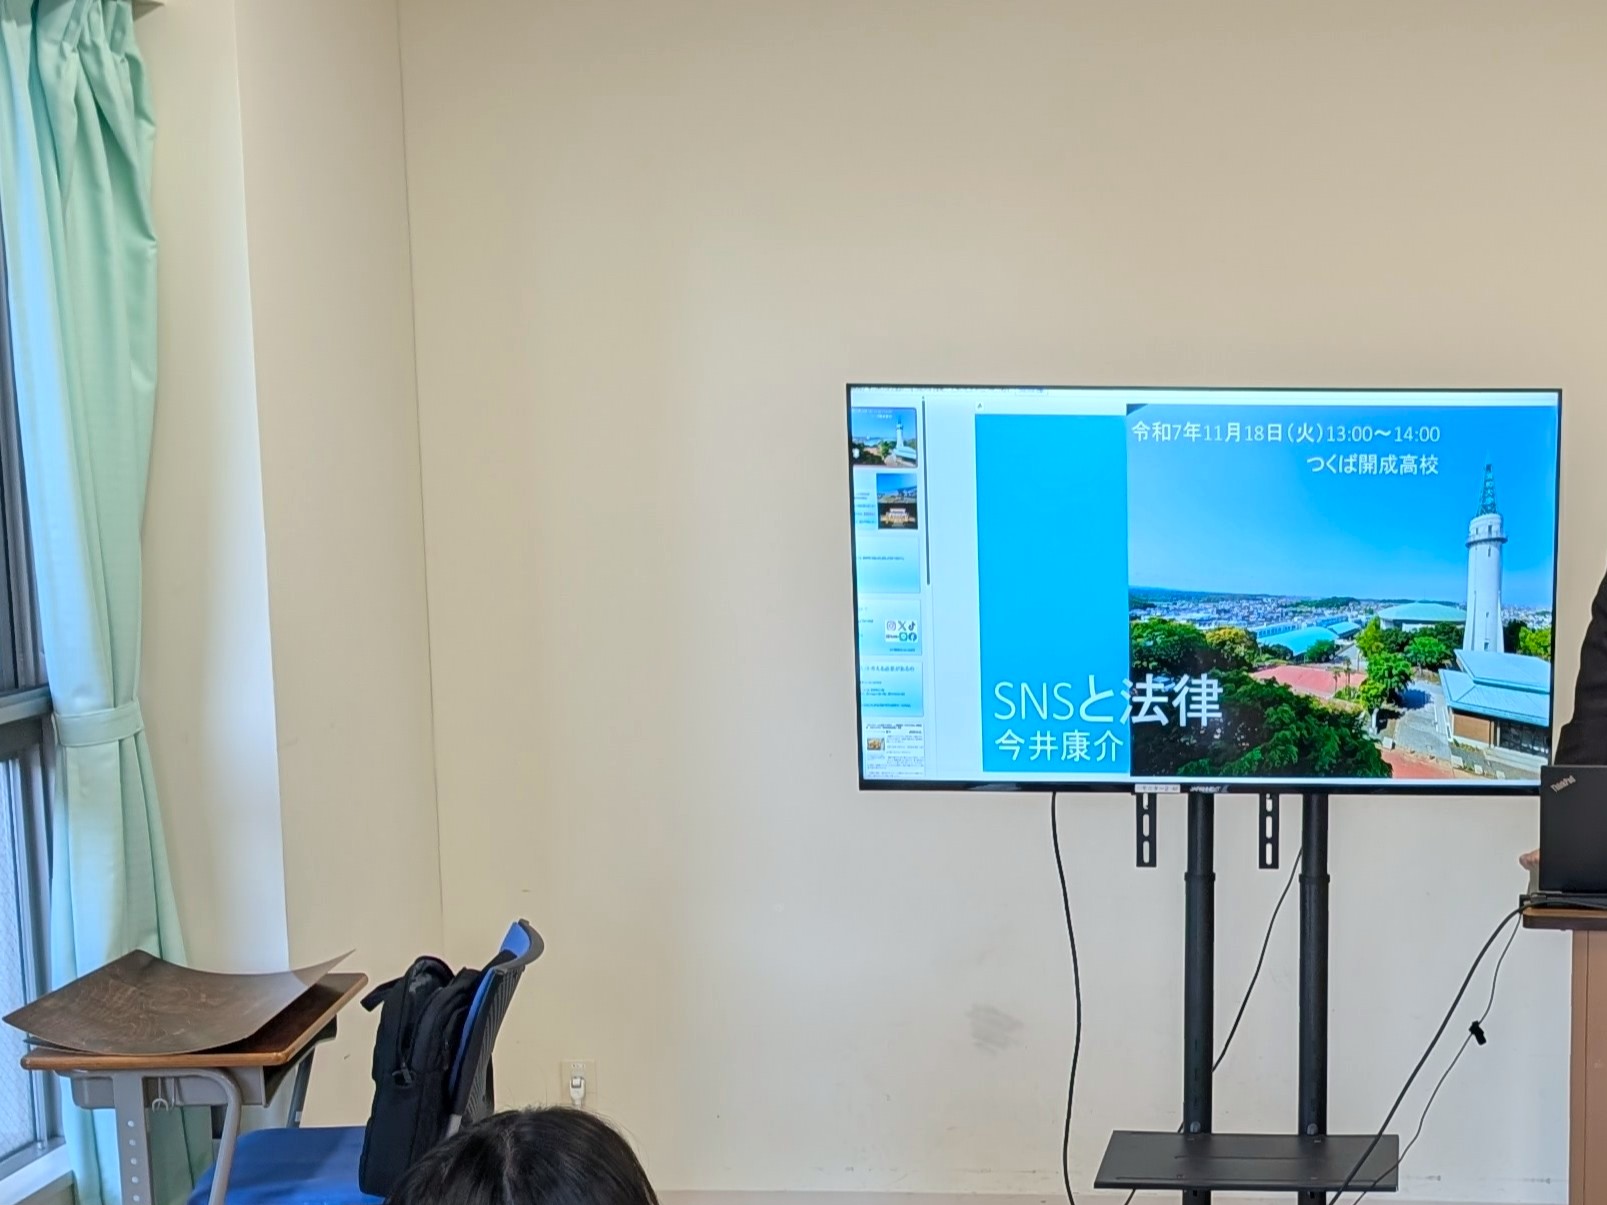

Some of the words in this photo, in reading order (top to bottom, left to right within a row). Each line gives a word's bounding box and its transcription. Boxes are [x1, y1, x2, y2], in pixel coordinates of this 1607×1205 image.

[1306, 453, 1439, 475] つくば開成高校
[993, 672, 1224, 728] SNSと法律
[994, 727, 1124, 762] 今井康介
